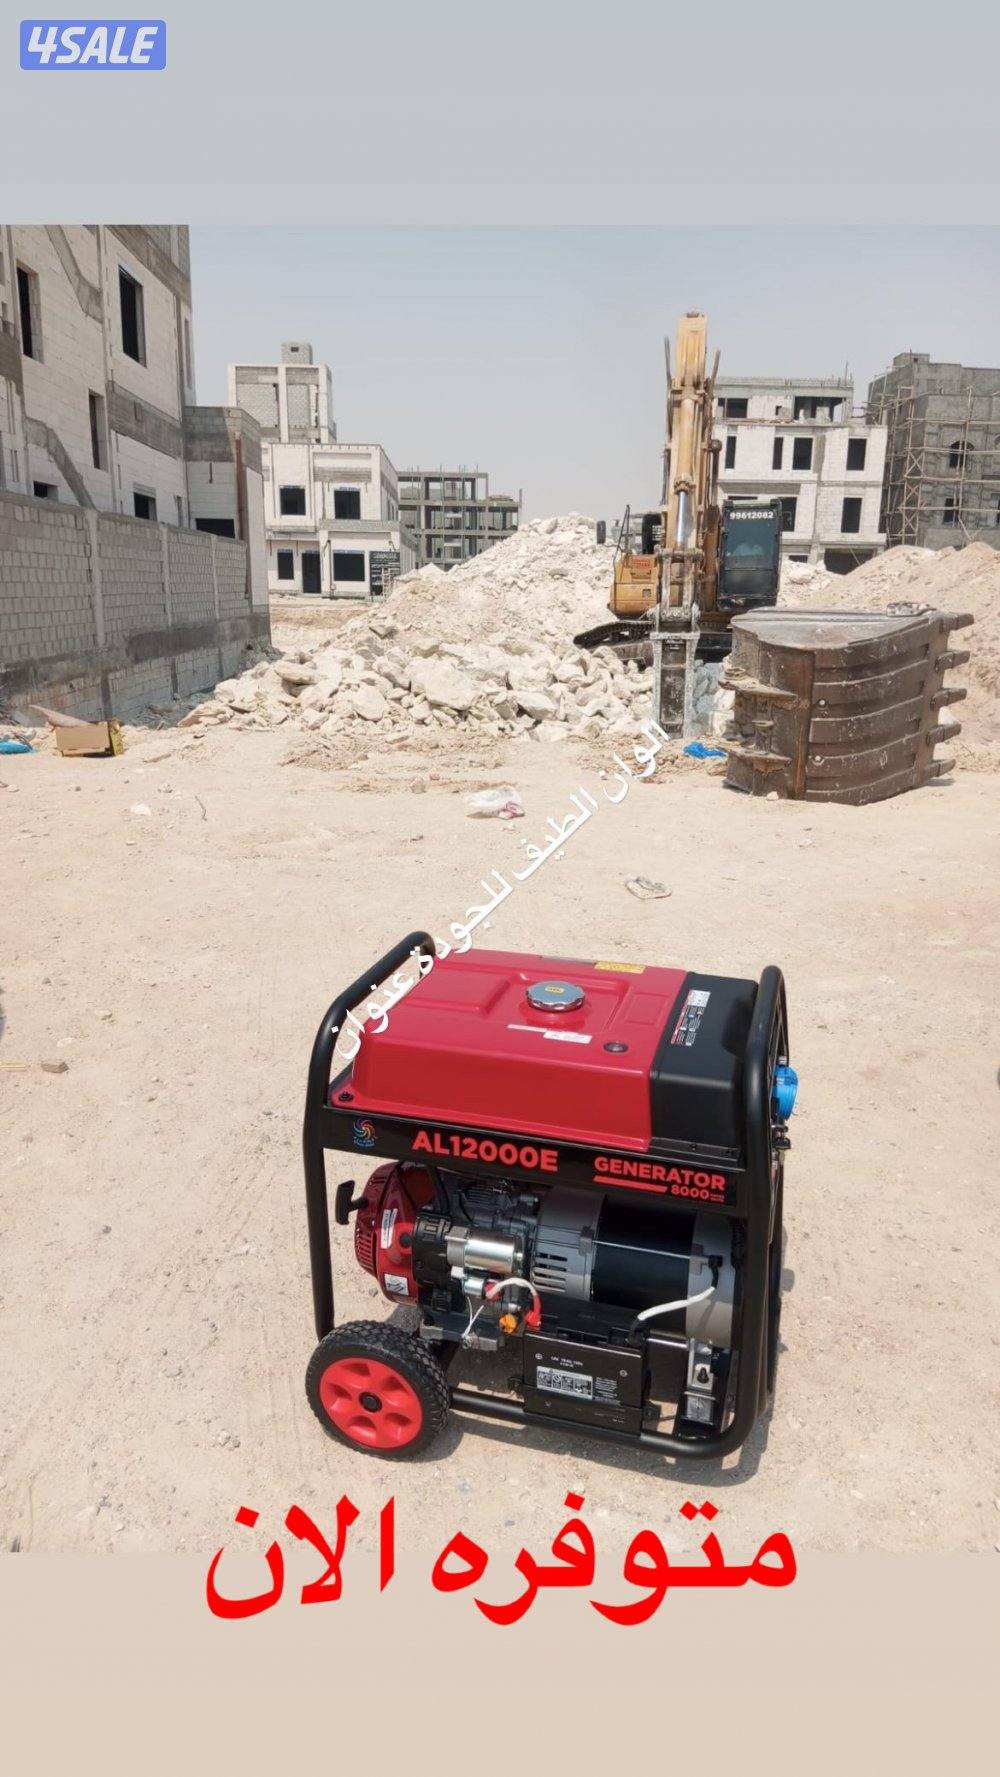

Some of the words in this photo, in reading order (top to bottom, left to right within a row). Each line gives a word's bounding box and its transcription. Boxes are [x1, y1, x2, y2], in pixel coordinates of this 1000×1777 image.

[411, 1130, 558, 1173] AL12000E
[594, 1156, 726, 1191] GENERATOR
[671, 1184, 710, 1200] 8000
